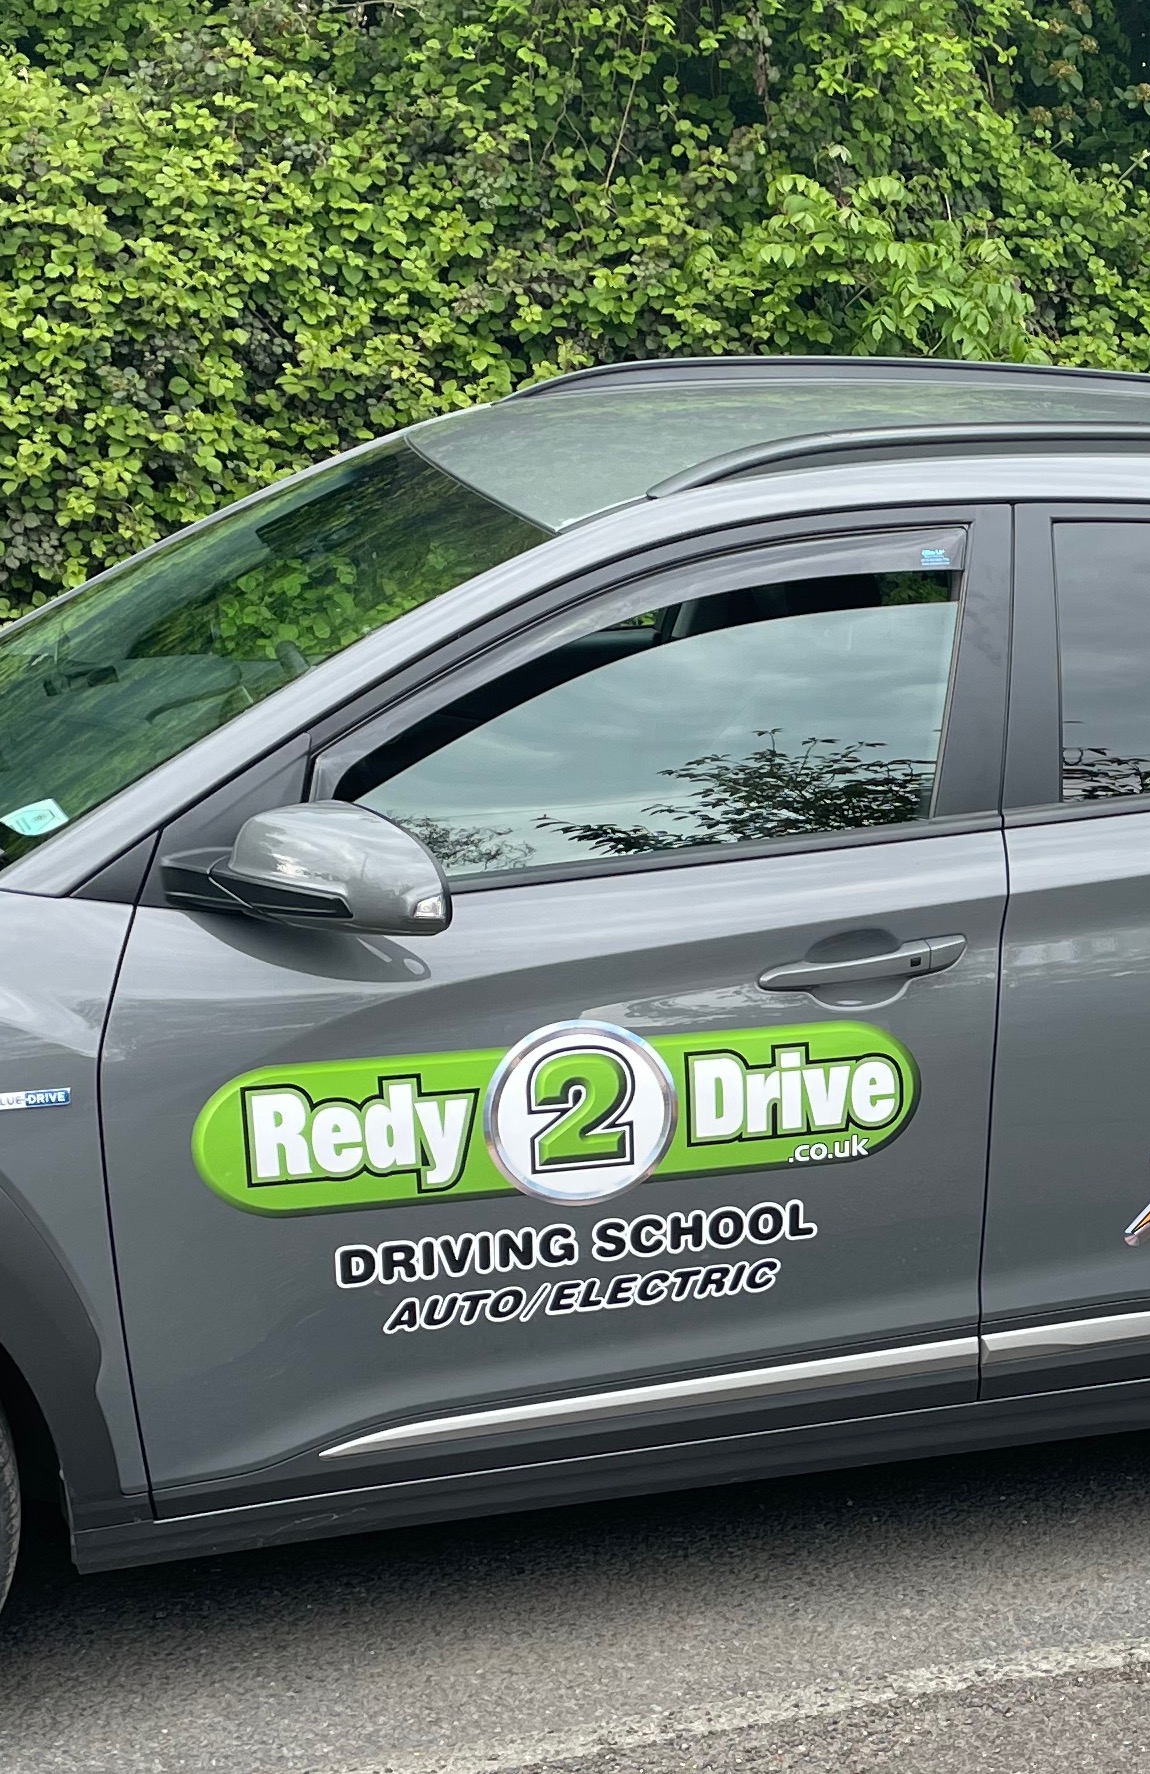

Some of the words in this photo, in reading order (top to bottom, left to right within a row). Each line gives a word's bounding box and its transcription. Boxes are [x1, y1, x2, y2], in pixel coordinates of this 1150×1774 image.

[249, 1082, 471, 1187] Redy
[529, 1048, 633, 1172] 2
[691, 1048, 900, 1140] Drive
[788, 1134, 869, 1164] .co.uk
[336, 1223, 578, 1289] DRIVING
[592, 1199, 818, 1258] SCHOOL
[383, 1257, 781, 1334] AUTO/ELECTRIC
